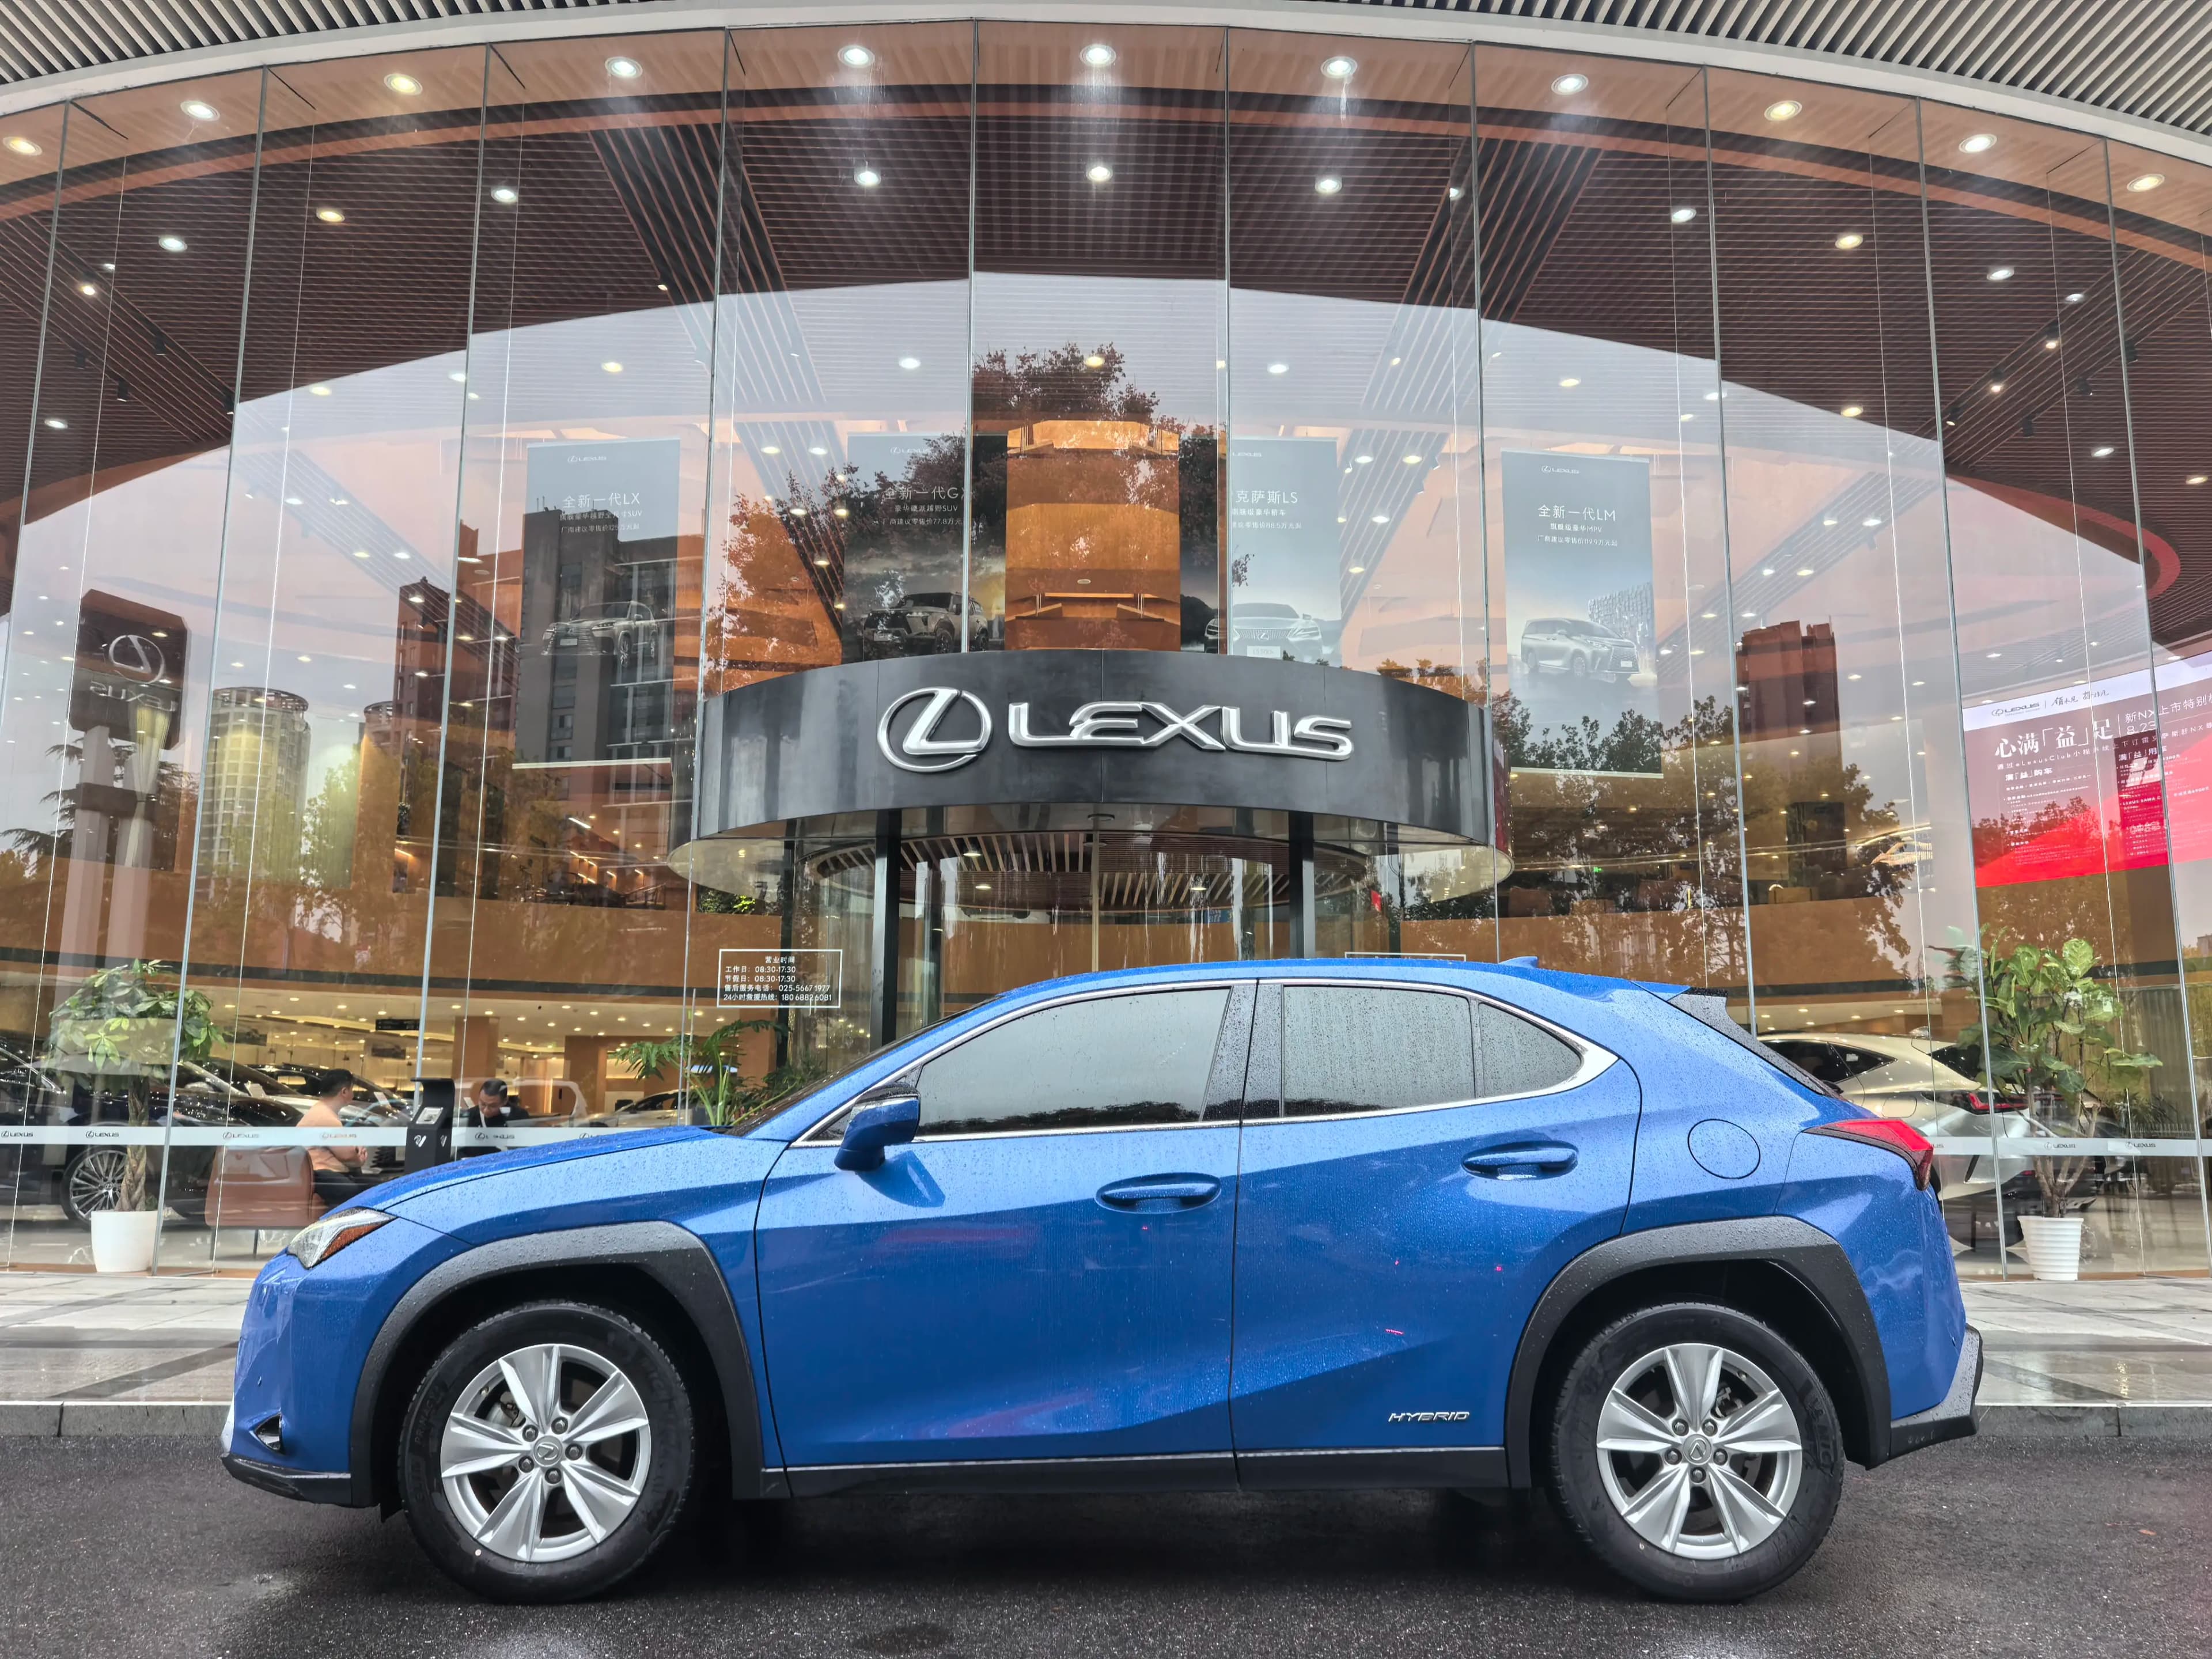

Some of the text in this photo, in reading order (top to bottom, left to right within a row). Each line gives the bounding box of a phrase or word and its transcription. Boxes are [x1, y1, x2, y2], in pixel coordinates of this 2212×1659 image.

[562, 493, 641, 508] 全新一代LX
[1235, 490, 1298, 504] 克萨斯LS
[1537, 504, 1616, 521] 全新一代LM
[2004, 702, 2040, 713] LEXUS
[1008, 700, 1354, 761] LEXUS
[764, 956, 796, 964] 营业时间
[1388, 1411, 1470, 1422] HYBRID
